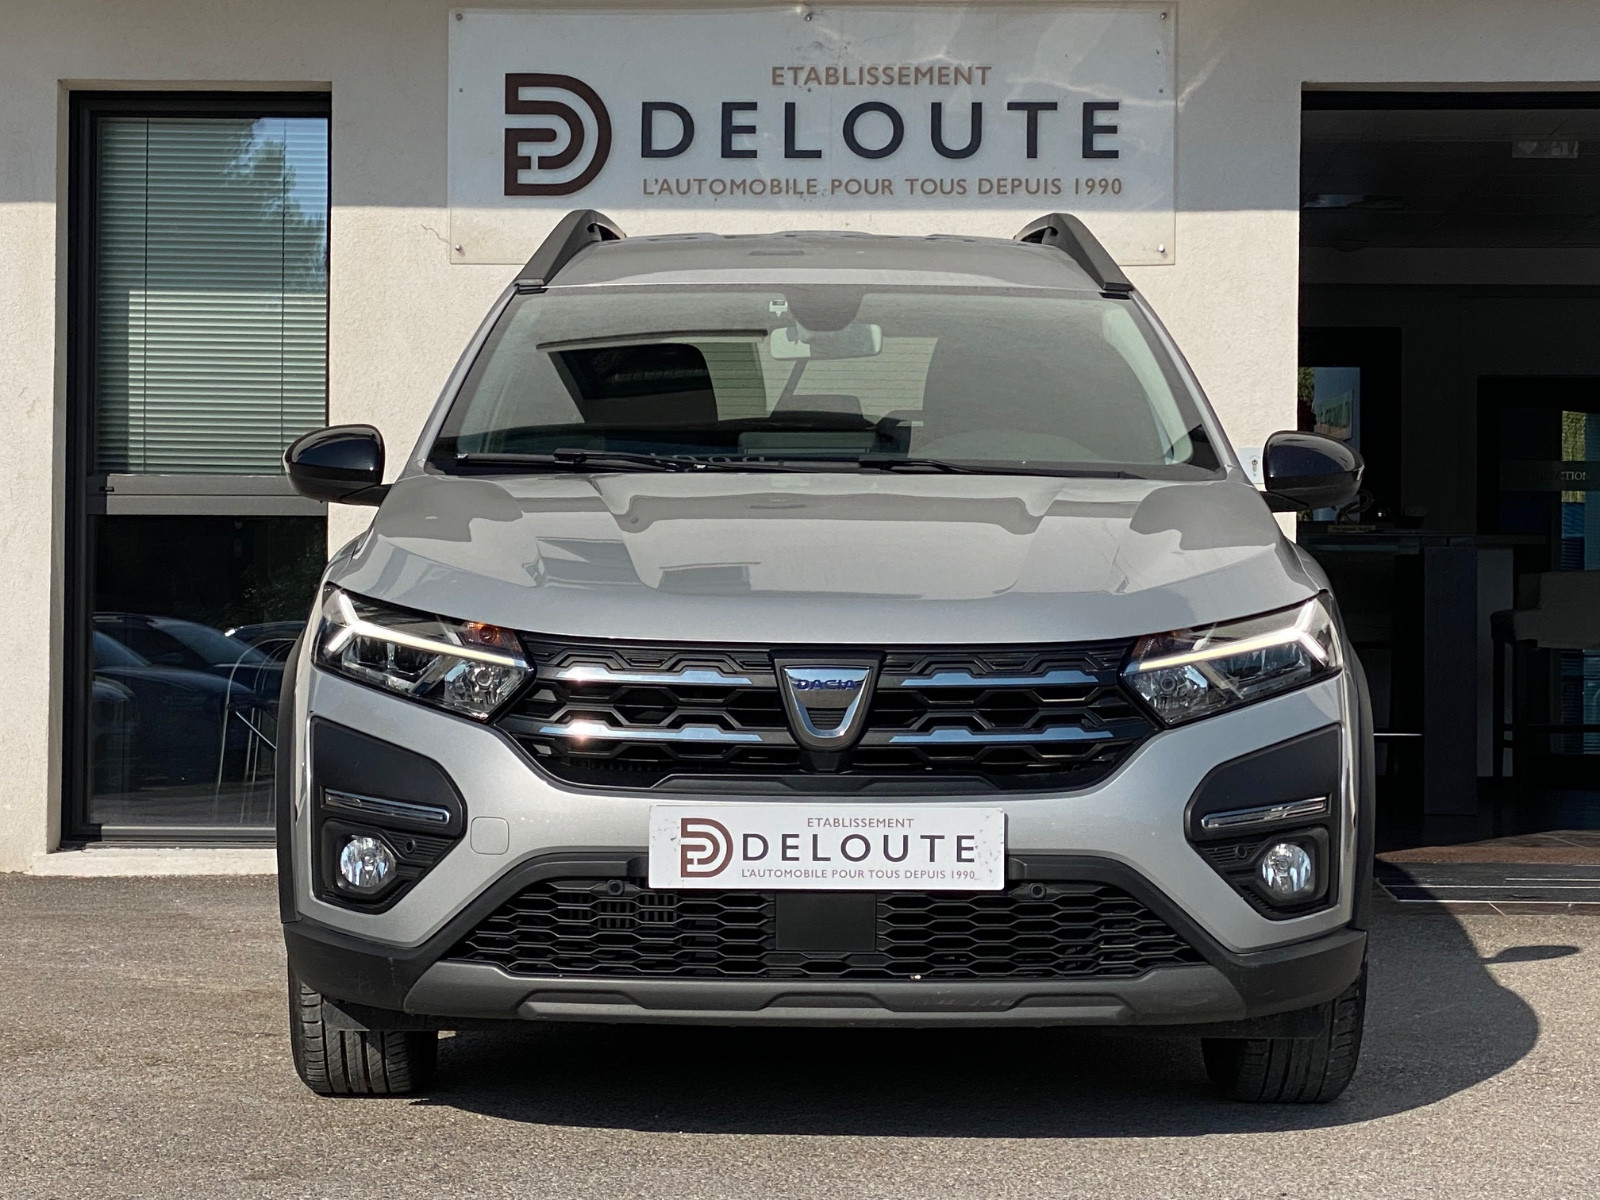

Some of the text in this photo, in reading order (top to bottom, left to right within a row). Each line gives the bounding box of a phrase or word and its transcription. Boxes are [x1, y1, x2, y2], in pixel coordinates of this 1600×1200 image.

[771, 66, 992, 87] ETABLISSEMENT
[641, 101, 1120, 160] DELOUTE
[643, 177, 1122, 196] L'AUTOMOBILE POUR TOUS DEPUIS 1990
[797, 679, 857, 690] DACIA
[806, 817, 915, 829] ETABLISSEMENT
[742, 833, 976, 864] DELOUTE
[831, 869, 865, 879] POUR
[868, 869, 901, 879] TOUS
[904, 870, 946, 880] DEPUIS
[951, 870, 976, 880] 1990
